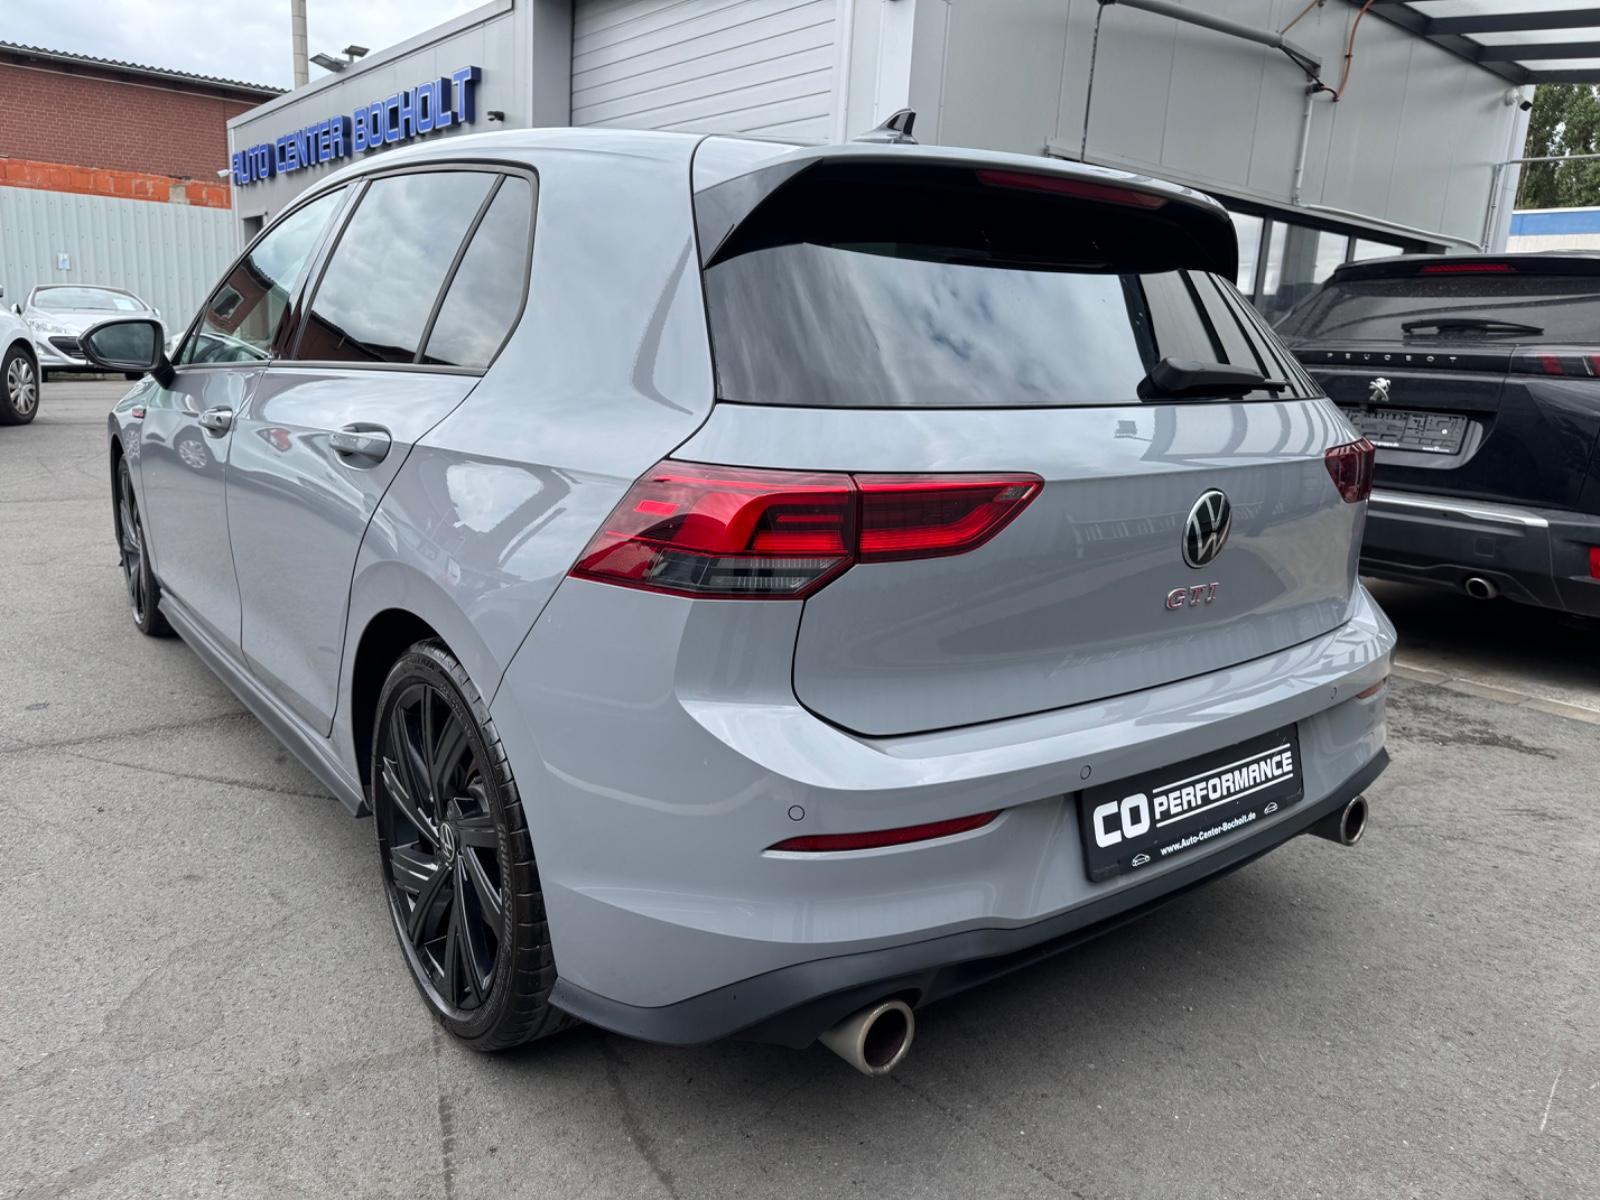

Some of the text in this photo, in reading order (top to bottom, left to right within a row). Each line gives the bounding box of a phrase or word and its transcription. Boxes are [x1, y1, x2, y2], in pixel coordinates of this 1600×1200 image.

[233, 65, 476, 186] AUTO CENTER BOCHOLT
[1327, 352, 1457, 363] PEUGEOT
[1166, 582, 1220, 609] GTI
[1093, 750, 1293, 848] CO PERFORMANCE
[1160, 811, 1257, 856] www.Auto-Center-Bocholt.de
